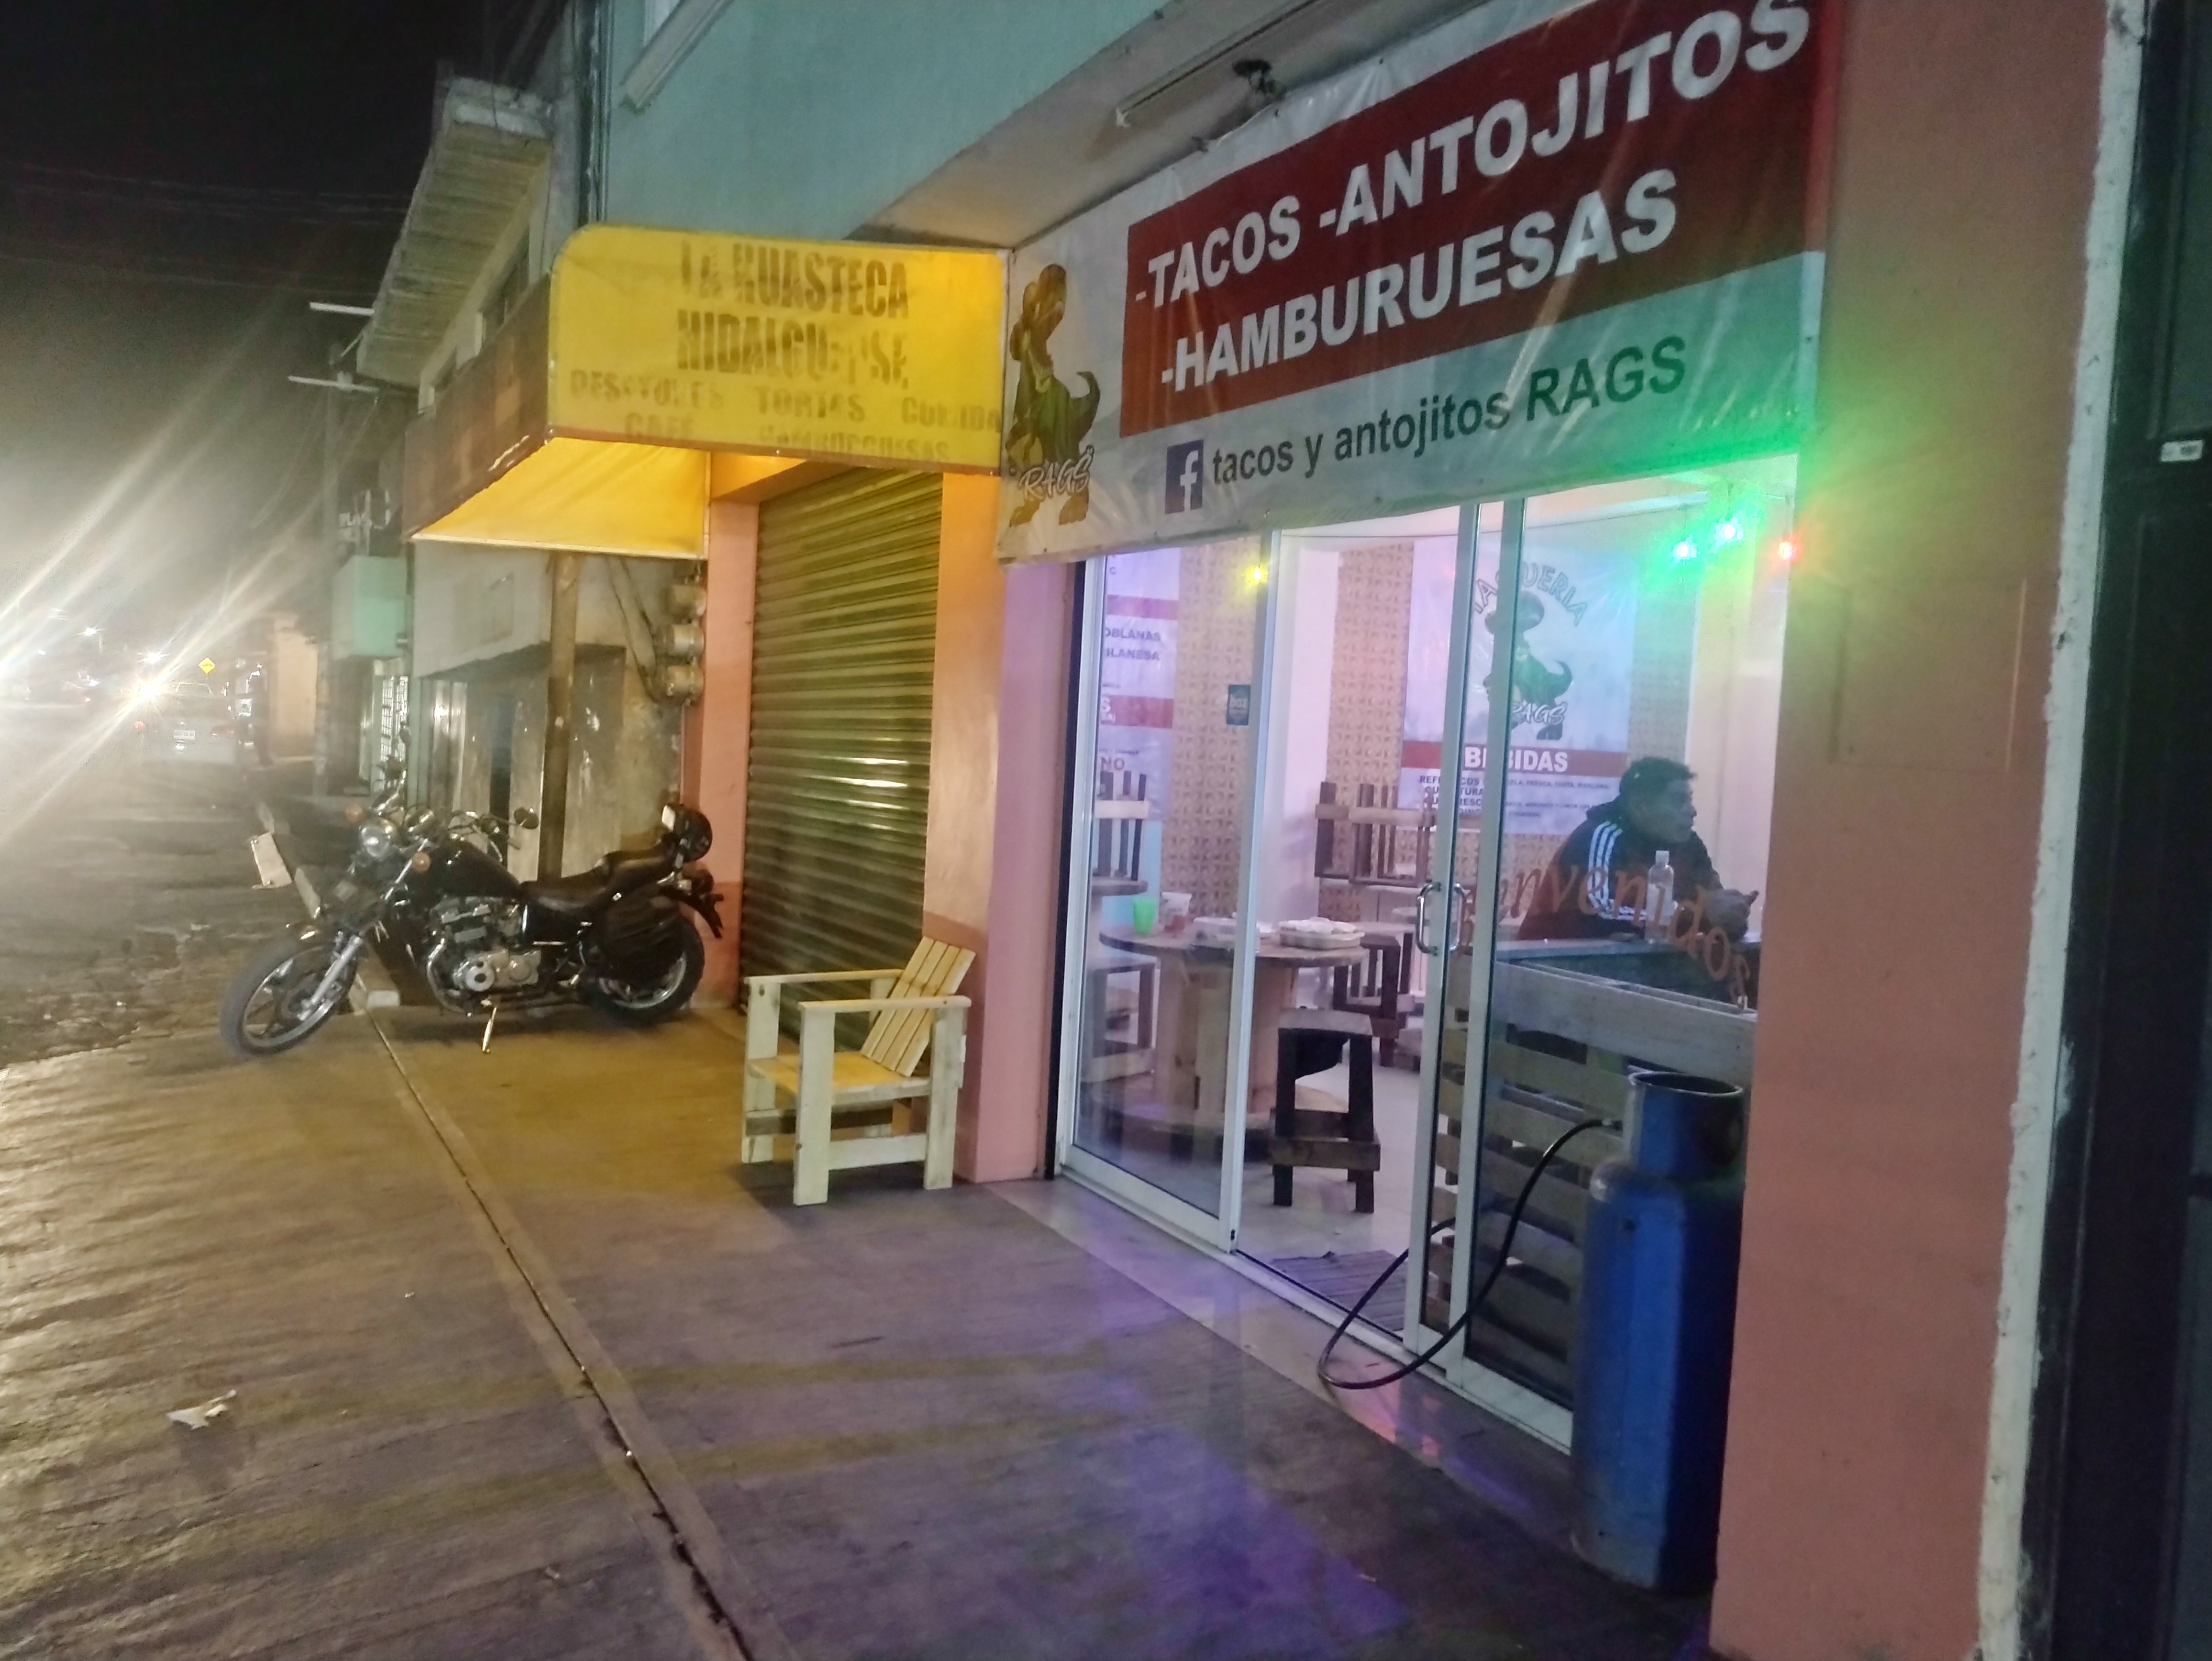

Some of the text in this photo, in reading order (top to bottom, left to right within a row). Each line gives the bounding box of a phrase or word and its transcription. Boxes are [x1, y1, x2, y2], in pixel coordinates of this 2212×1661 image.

[1136, 0, 1810, 308] -TACOS -ANTOJITOS
[732, 243, 908, 319] HUASTECA
[1161, 169, 1677, 391] -HAMBURUESAS
[677, 309, 908, 389] HIDALGUSE
[1213, 440, 1293, 485] tacos
[1305, 433, 1323, 478] y
[1335, 392, 1510, 461] antojitos
[1526, 336, 1686, 421] RAGS
[1018, 444, 1095, 502] RAGS
[1474, 562, 1588, 627] AUERIA
[1104, 627, 1161, 641] OBLANAS
[1105, 648, 1160, 661] ILANESA
